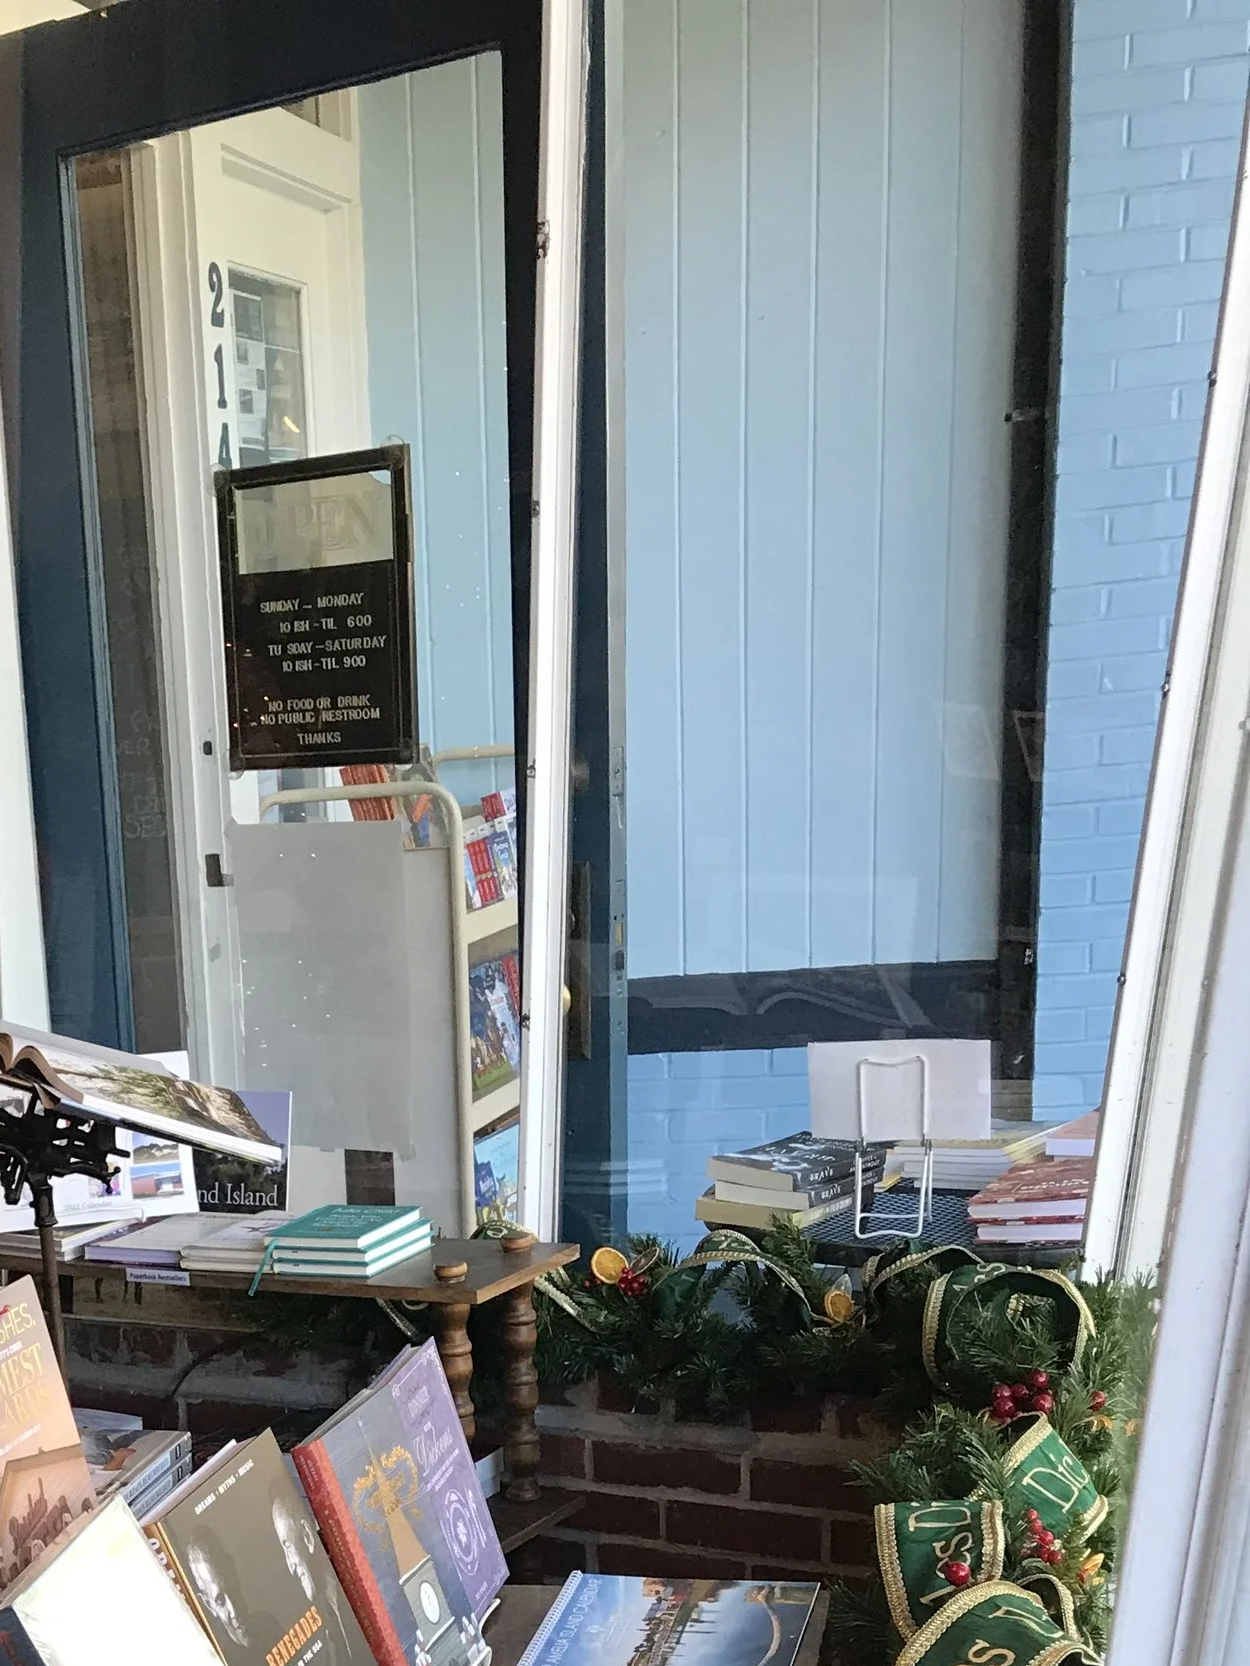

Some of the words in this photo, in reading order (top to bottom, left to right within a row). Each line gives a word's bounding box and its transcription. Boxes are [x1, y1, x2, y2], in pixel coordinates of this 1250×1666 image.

[260, 599, 300, 614] SUNDAY
[317, 592, 364, 608] MONDAY
[279, 621, 291, 633] 10
[347, 614, 372, 628] 600
[282, 660, 292, 673] 10
[343, 656, 366, 670] 900
[268, 699, 283, 712] NO
[287, 698, 314, 712] FOOD
[316, 696, 331, 710] OR
[337, 694, 371, 708] DRINK
[261, 712, 276, 726] NO
[278, 709, 315, 724] PUBLIC
[321, 706, 381, 722] RESTROOM
[296, 731, 342, 746] THANKS
[227, 1182, 279, 1207] Island
[194, 1492, 217, 1515] DREAMS
[218, 1475, 237, 1495] MYTHS
[237, 1459, 255, 1477] MUSIC
[572, 1577, 604, 1616] CALENDAR
